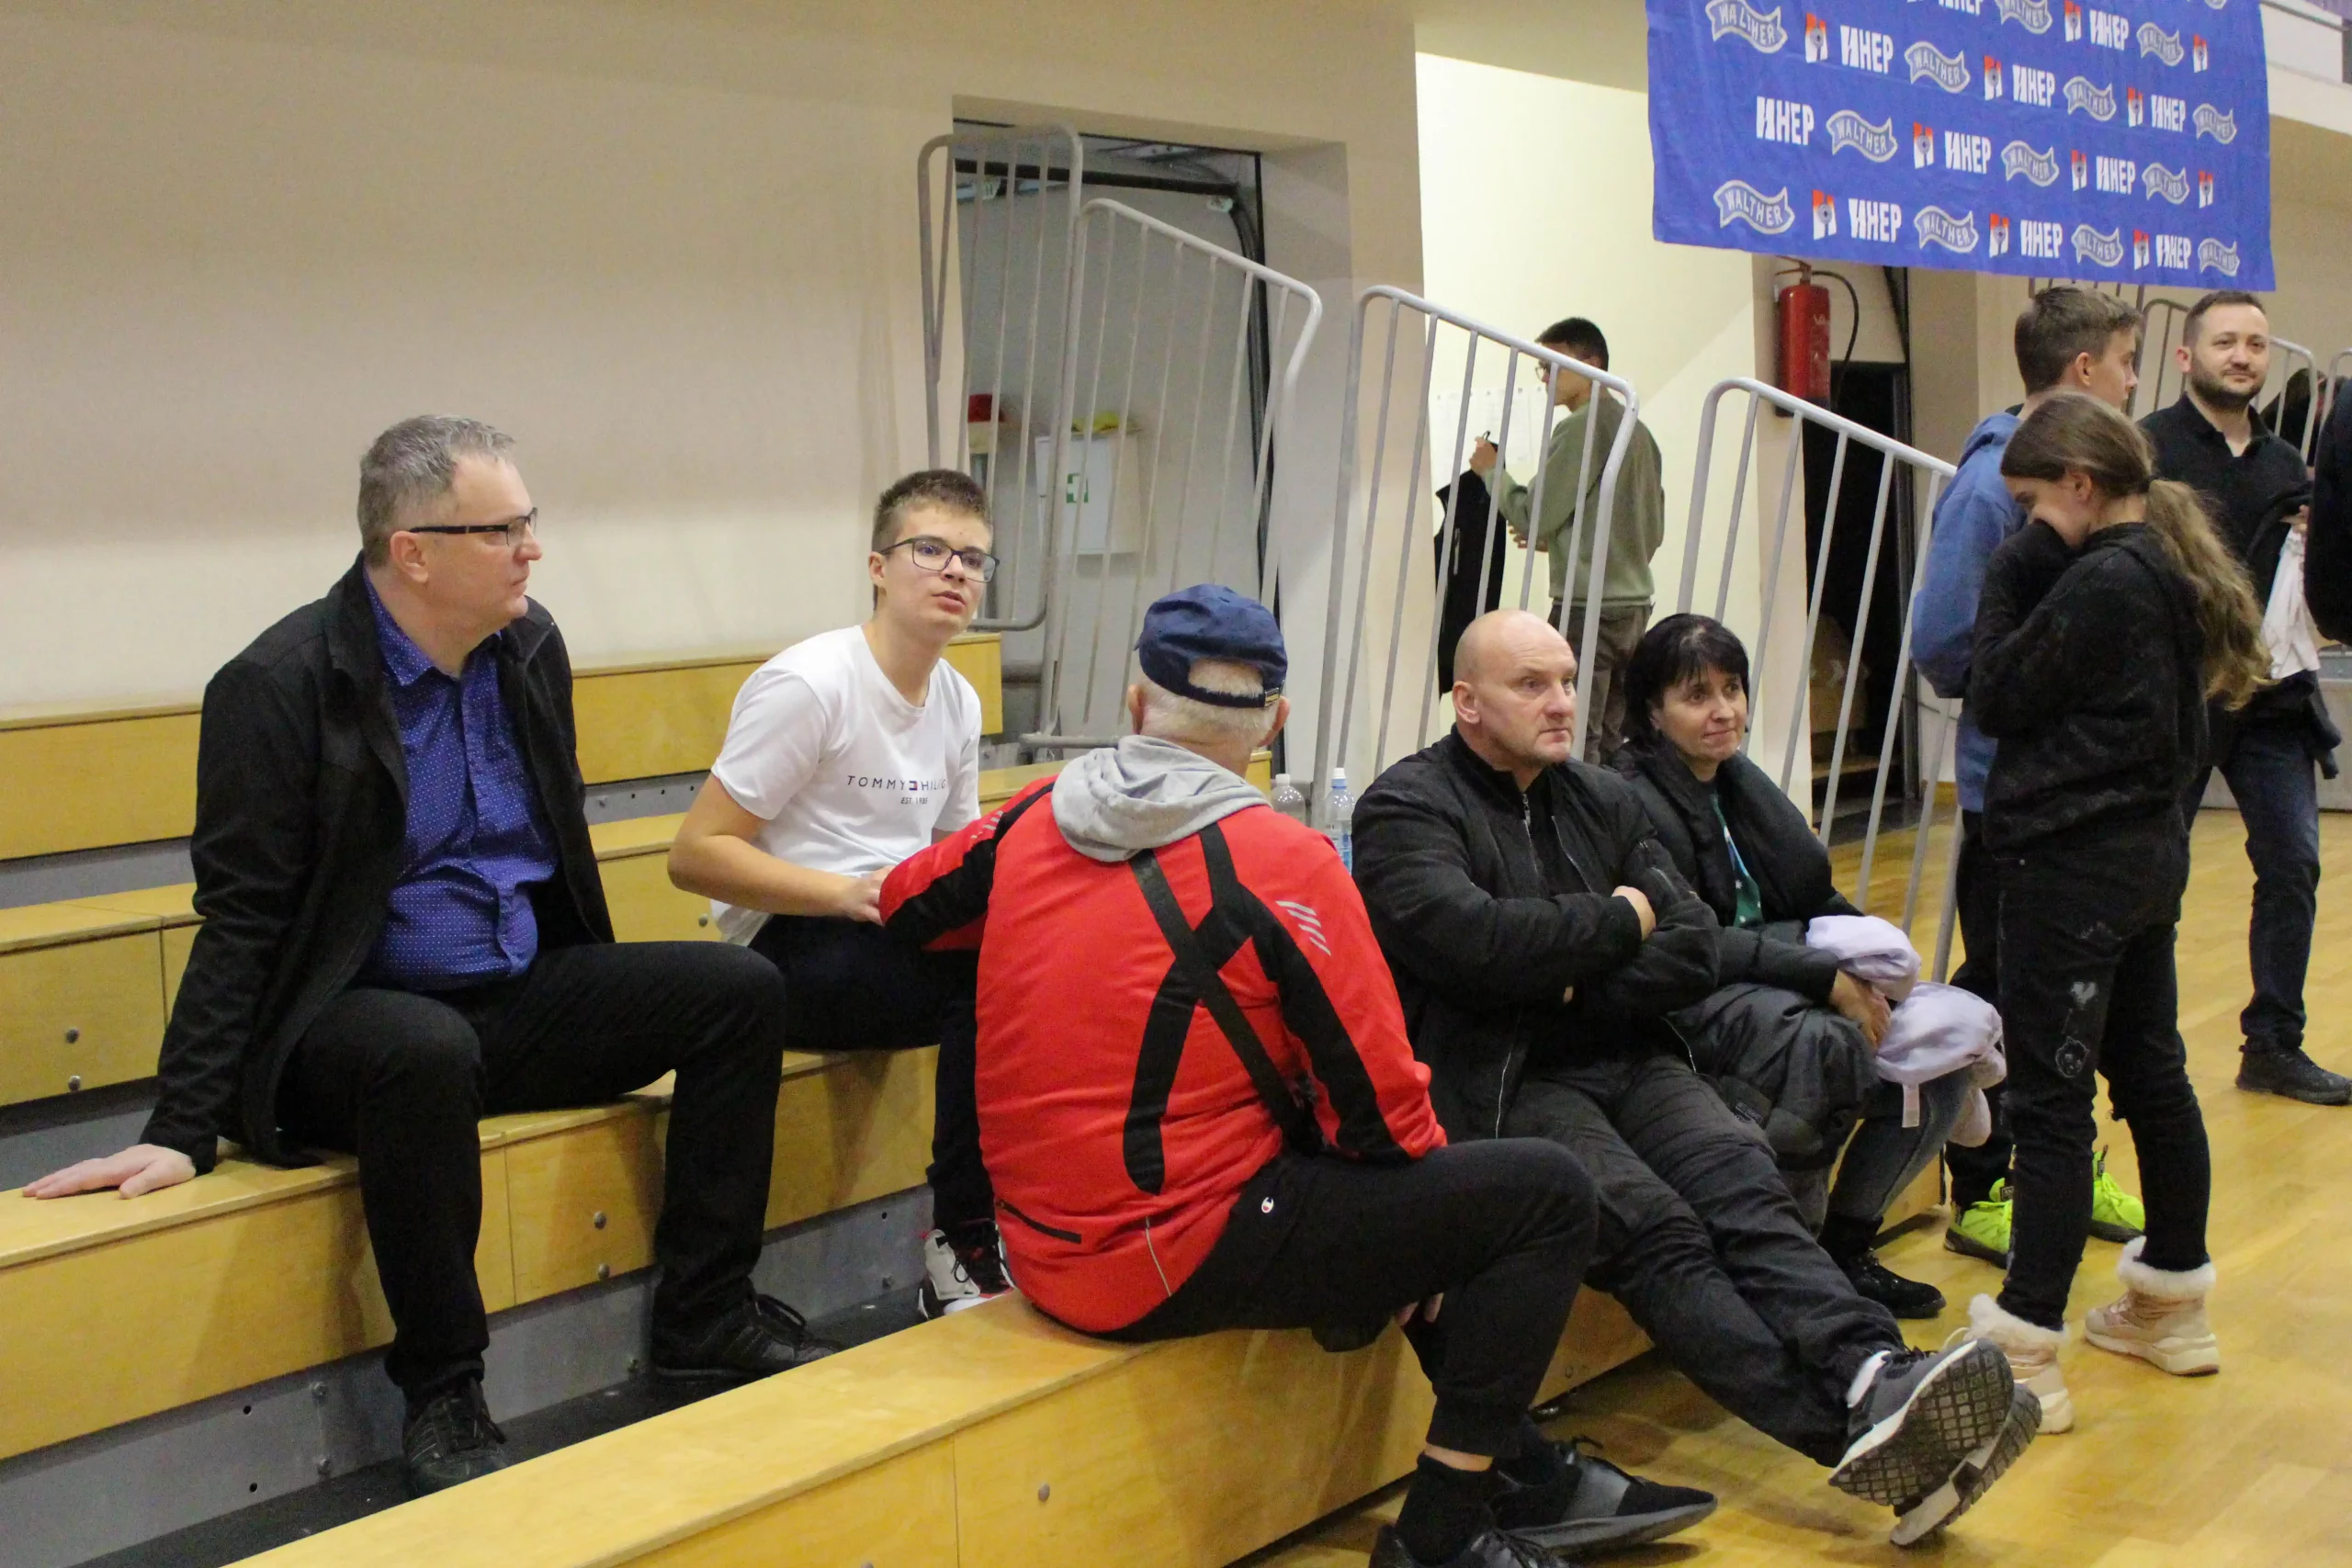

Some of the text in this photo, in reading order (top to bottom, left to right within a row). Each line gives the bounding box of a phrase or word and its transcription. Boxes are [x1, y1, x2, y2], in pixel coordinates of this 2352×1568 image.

[1719, 3, 1776, 45] WALTHER
[2089, 8, 2130, 51] ИНЕР
[1839, 24, 1894, 74] ИНЕР
[1913, 49, 1962, 85] WALTHER
[2012, 63, 2056, 107] ИНЕР
[1756, 96, 1815, 147] ИНЕР
[2151, 95, 2187, 133] ИНЕР
[1836, 118, 1888, 154] WALTHER
[1944, 130, 1993, 175] ИНЕР
[2096, 155, 2137, 196] ИНЕР
[1724, 188, 1784, 227] WALTHER
[1848, 197, 1903, 244] ИНЕР
[1922, 213, 1970, 246] WALTHER
[2020, 219, 2064, 259] ИНЕР
[846, 774, 906, 791] TOMMY
